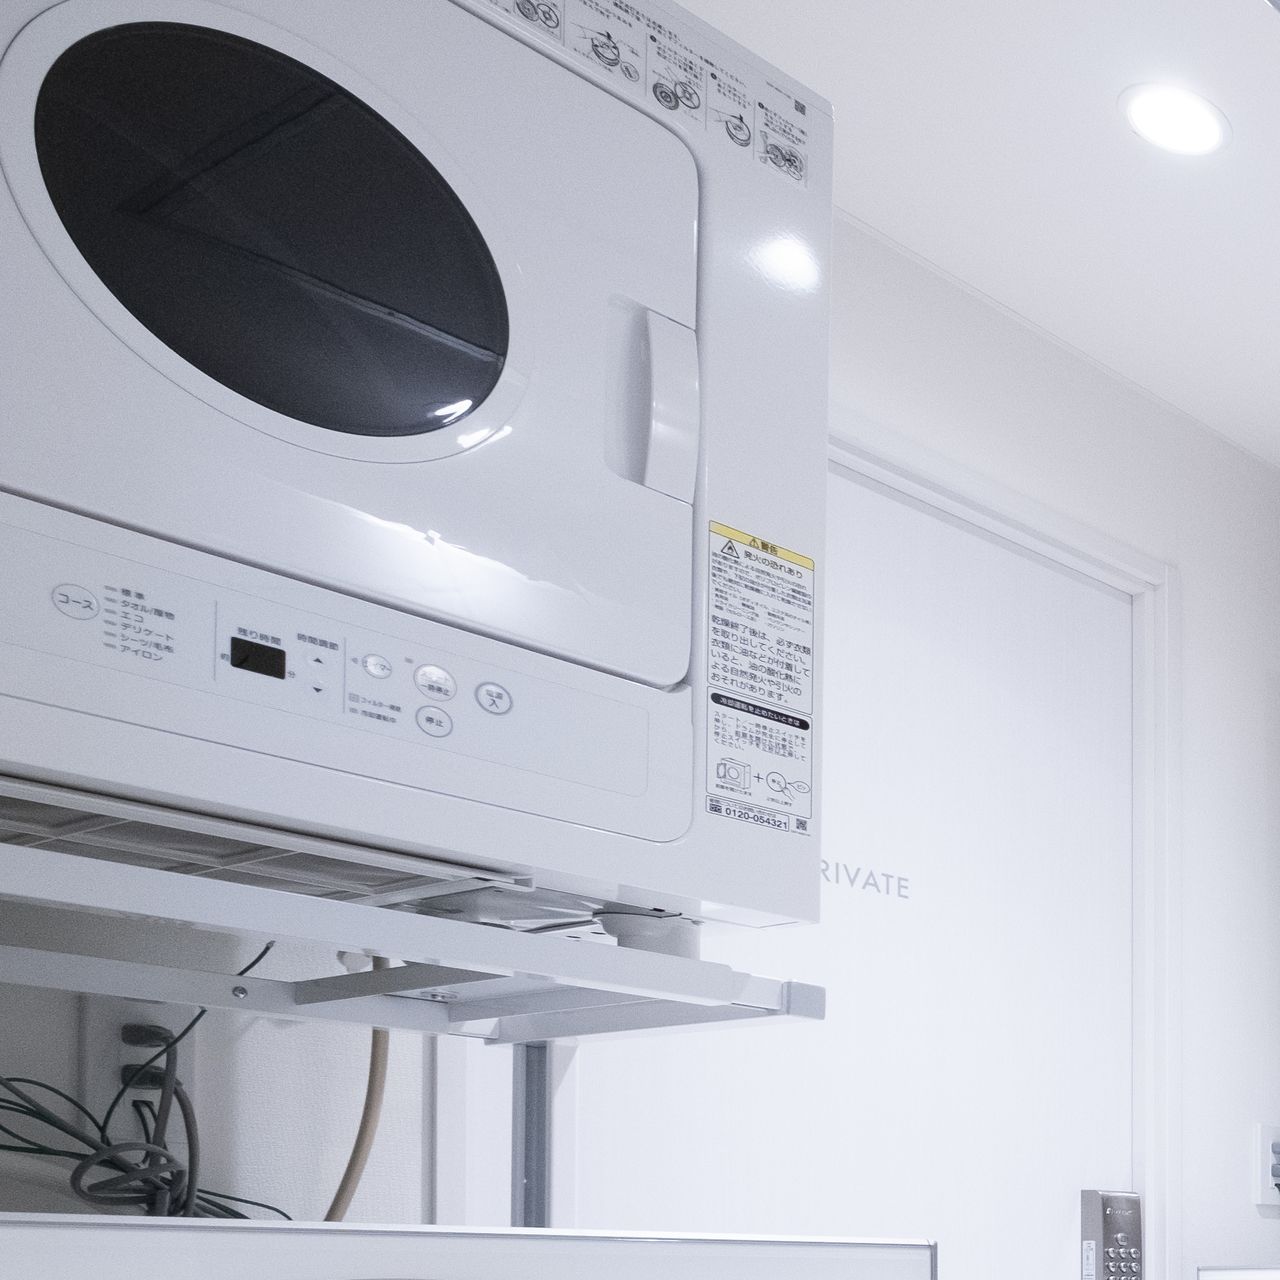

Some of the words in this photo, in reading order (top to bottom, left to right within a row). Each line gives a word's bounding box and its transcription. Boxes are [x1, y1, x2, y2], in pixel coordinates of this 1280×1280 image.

[744, 550, 803, 579] 発火の恐れあり
[58, 592, 94, 611] コース
[120, 611, 144, 624] エコ
[120, 644, 164, 661] アイロン
[725, 807, 788, 830] 0120-054321
